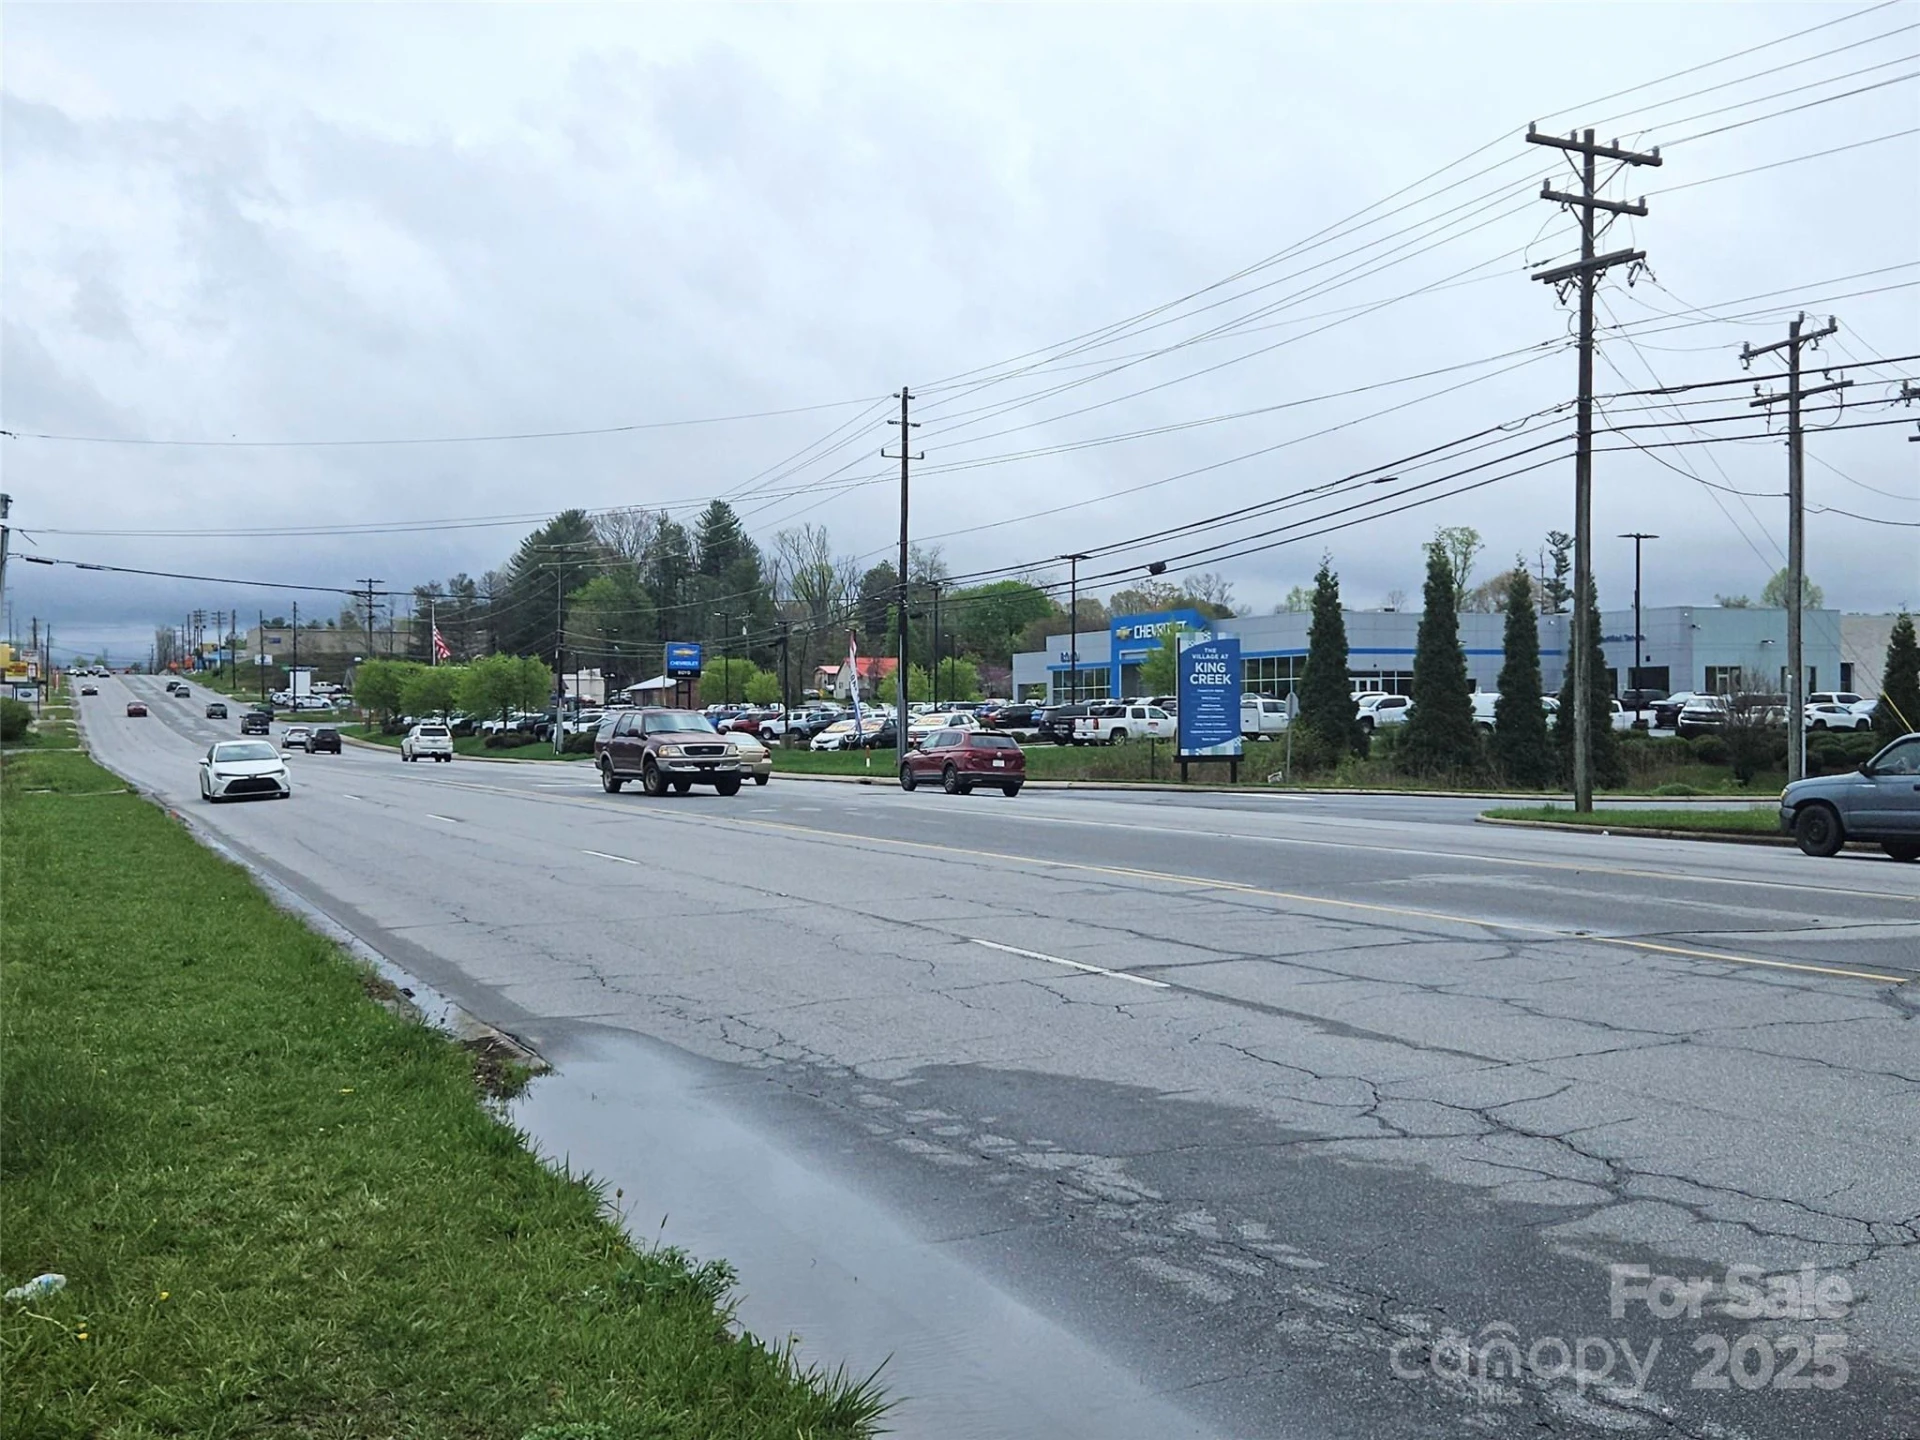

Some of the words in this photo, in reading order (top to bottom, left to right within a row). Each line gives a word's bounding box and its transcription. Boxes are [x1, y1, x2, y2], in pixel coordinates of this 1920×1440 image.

[1134, 621, 1187, 639] CHEVROT
[1195, 662, 1226, 673] KING
[1190, 673, 1232, 685] CREEK
